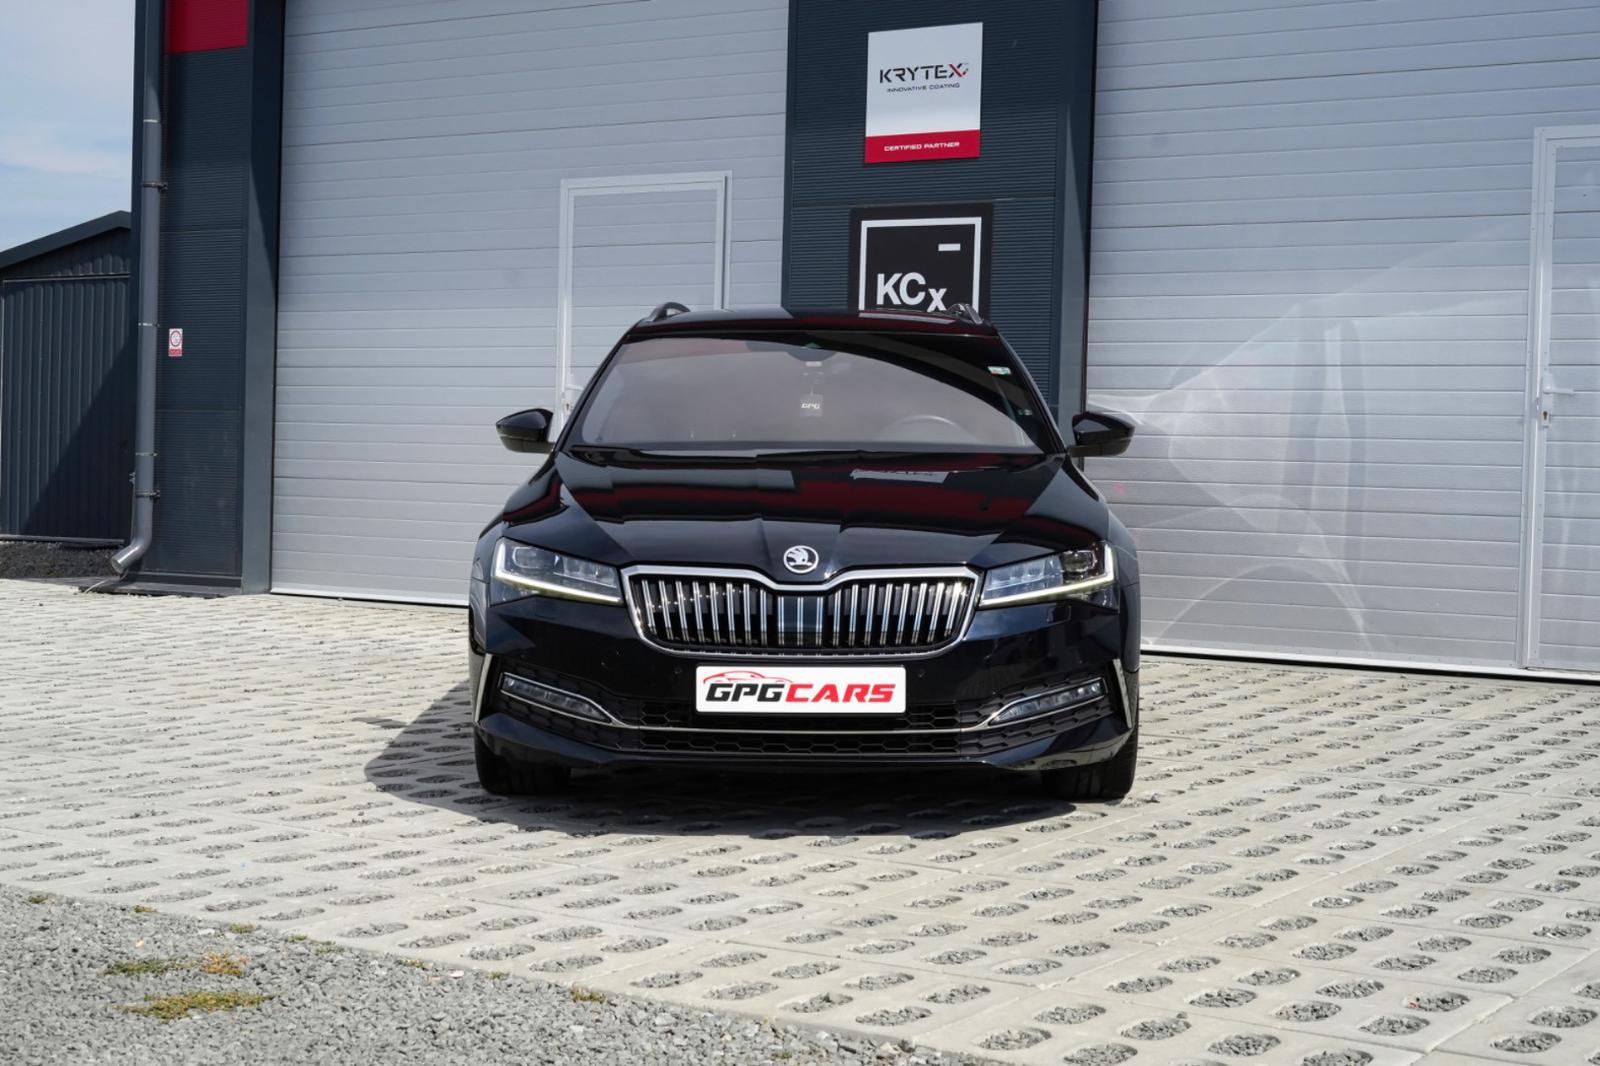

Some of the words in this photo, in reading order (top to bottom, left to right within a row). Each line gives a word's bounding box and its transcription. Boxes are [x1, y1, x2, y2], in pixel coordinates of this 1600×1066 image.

[879, 63, 963, 84] KRYTEX
[887, 85, 927, 93] INNOVATIVE
[929, 82, 961, 91] COATING
[883, 143, 923, 152] CERTIFIED
[924, 141, 960, 150] PARTNER
